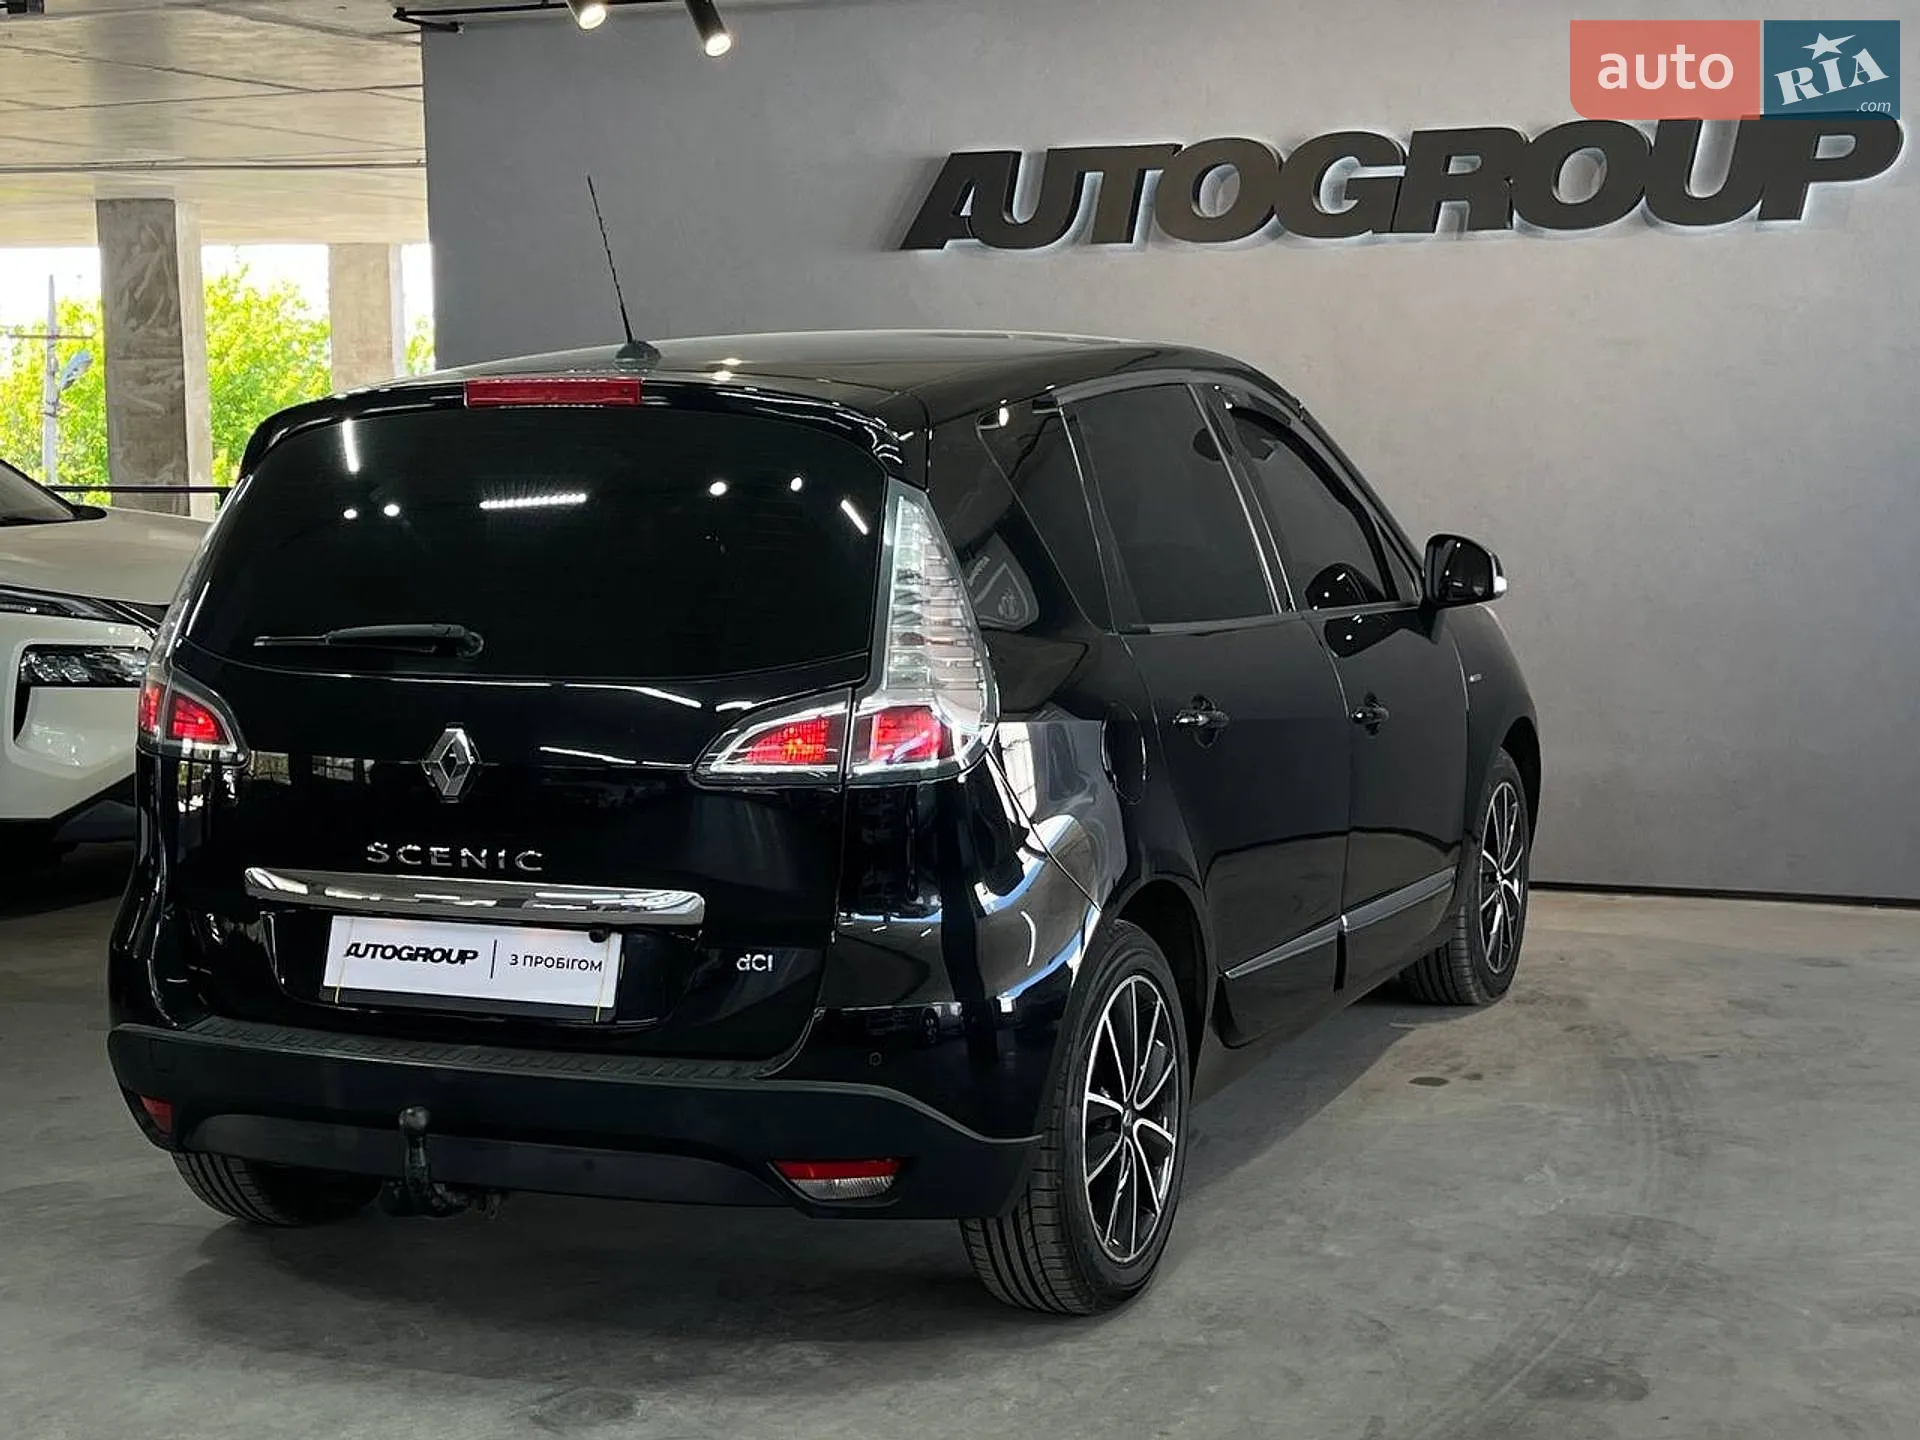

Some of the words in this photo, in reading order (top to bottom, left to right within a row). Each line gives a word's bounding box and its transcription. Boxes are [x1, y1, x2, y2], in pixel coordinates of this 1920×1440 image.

[900, 111, 1904, 251] AUTOGROUP
[366, 841, 544, 872] SCENIC
[345, 942, 479, 965] AUTOGROUP
[523, 955, 603, 972] ПРОБІГОМ
